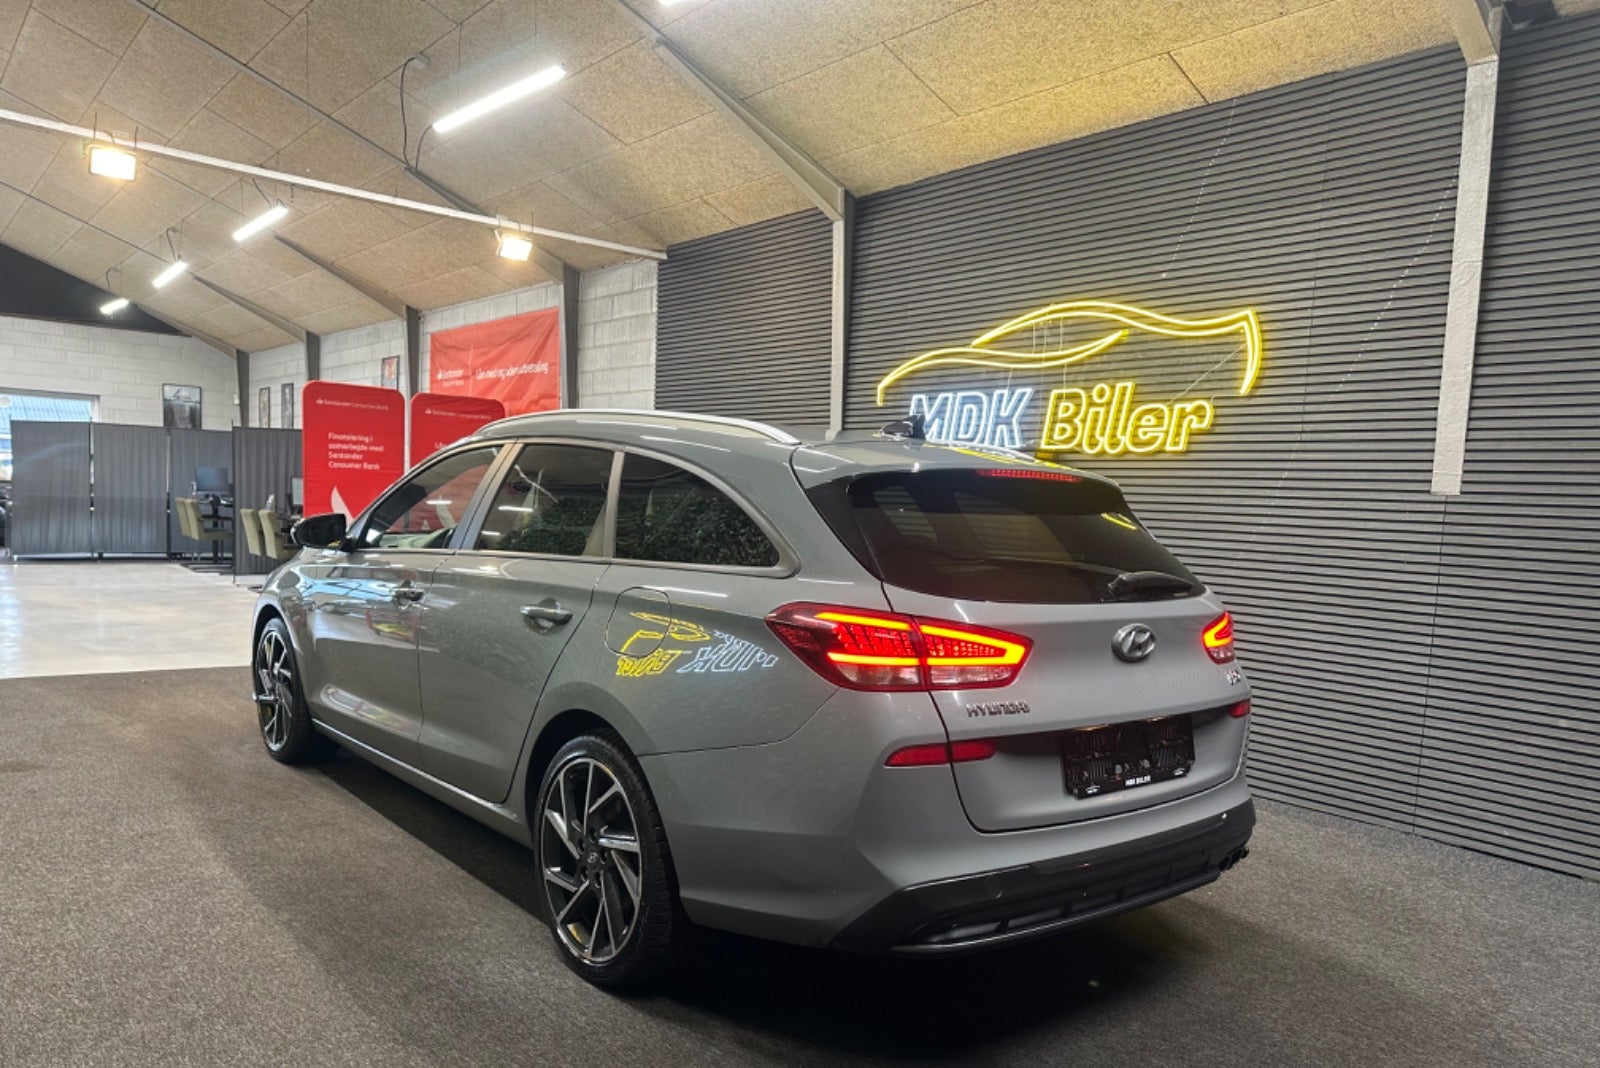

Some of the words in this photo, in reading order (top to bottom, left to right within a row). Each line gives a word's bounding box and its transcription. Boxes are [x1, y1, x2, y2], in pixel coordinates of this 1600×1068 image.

[909, 387, 1033, 449] MDK
[1040, 382, 1214, 454] Biler
[328, 432, 369, 443] Finansiering
[328, 443, 368, 452] samarbejde
[328, 451, 364, 460] Santander
[328, 461, 362, 469] Consumer
[363, 462, 380, 470] Bank
[966, 700, 1031, 718] HYUNDAI
